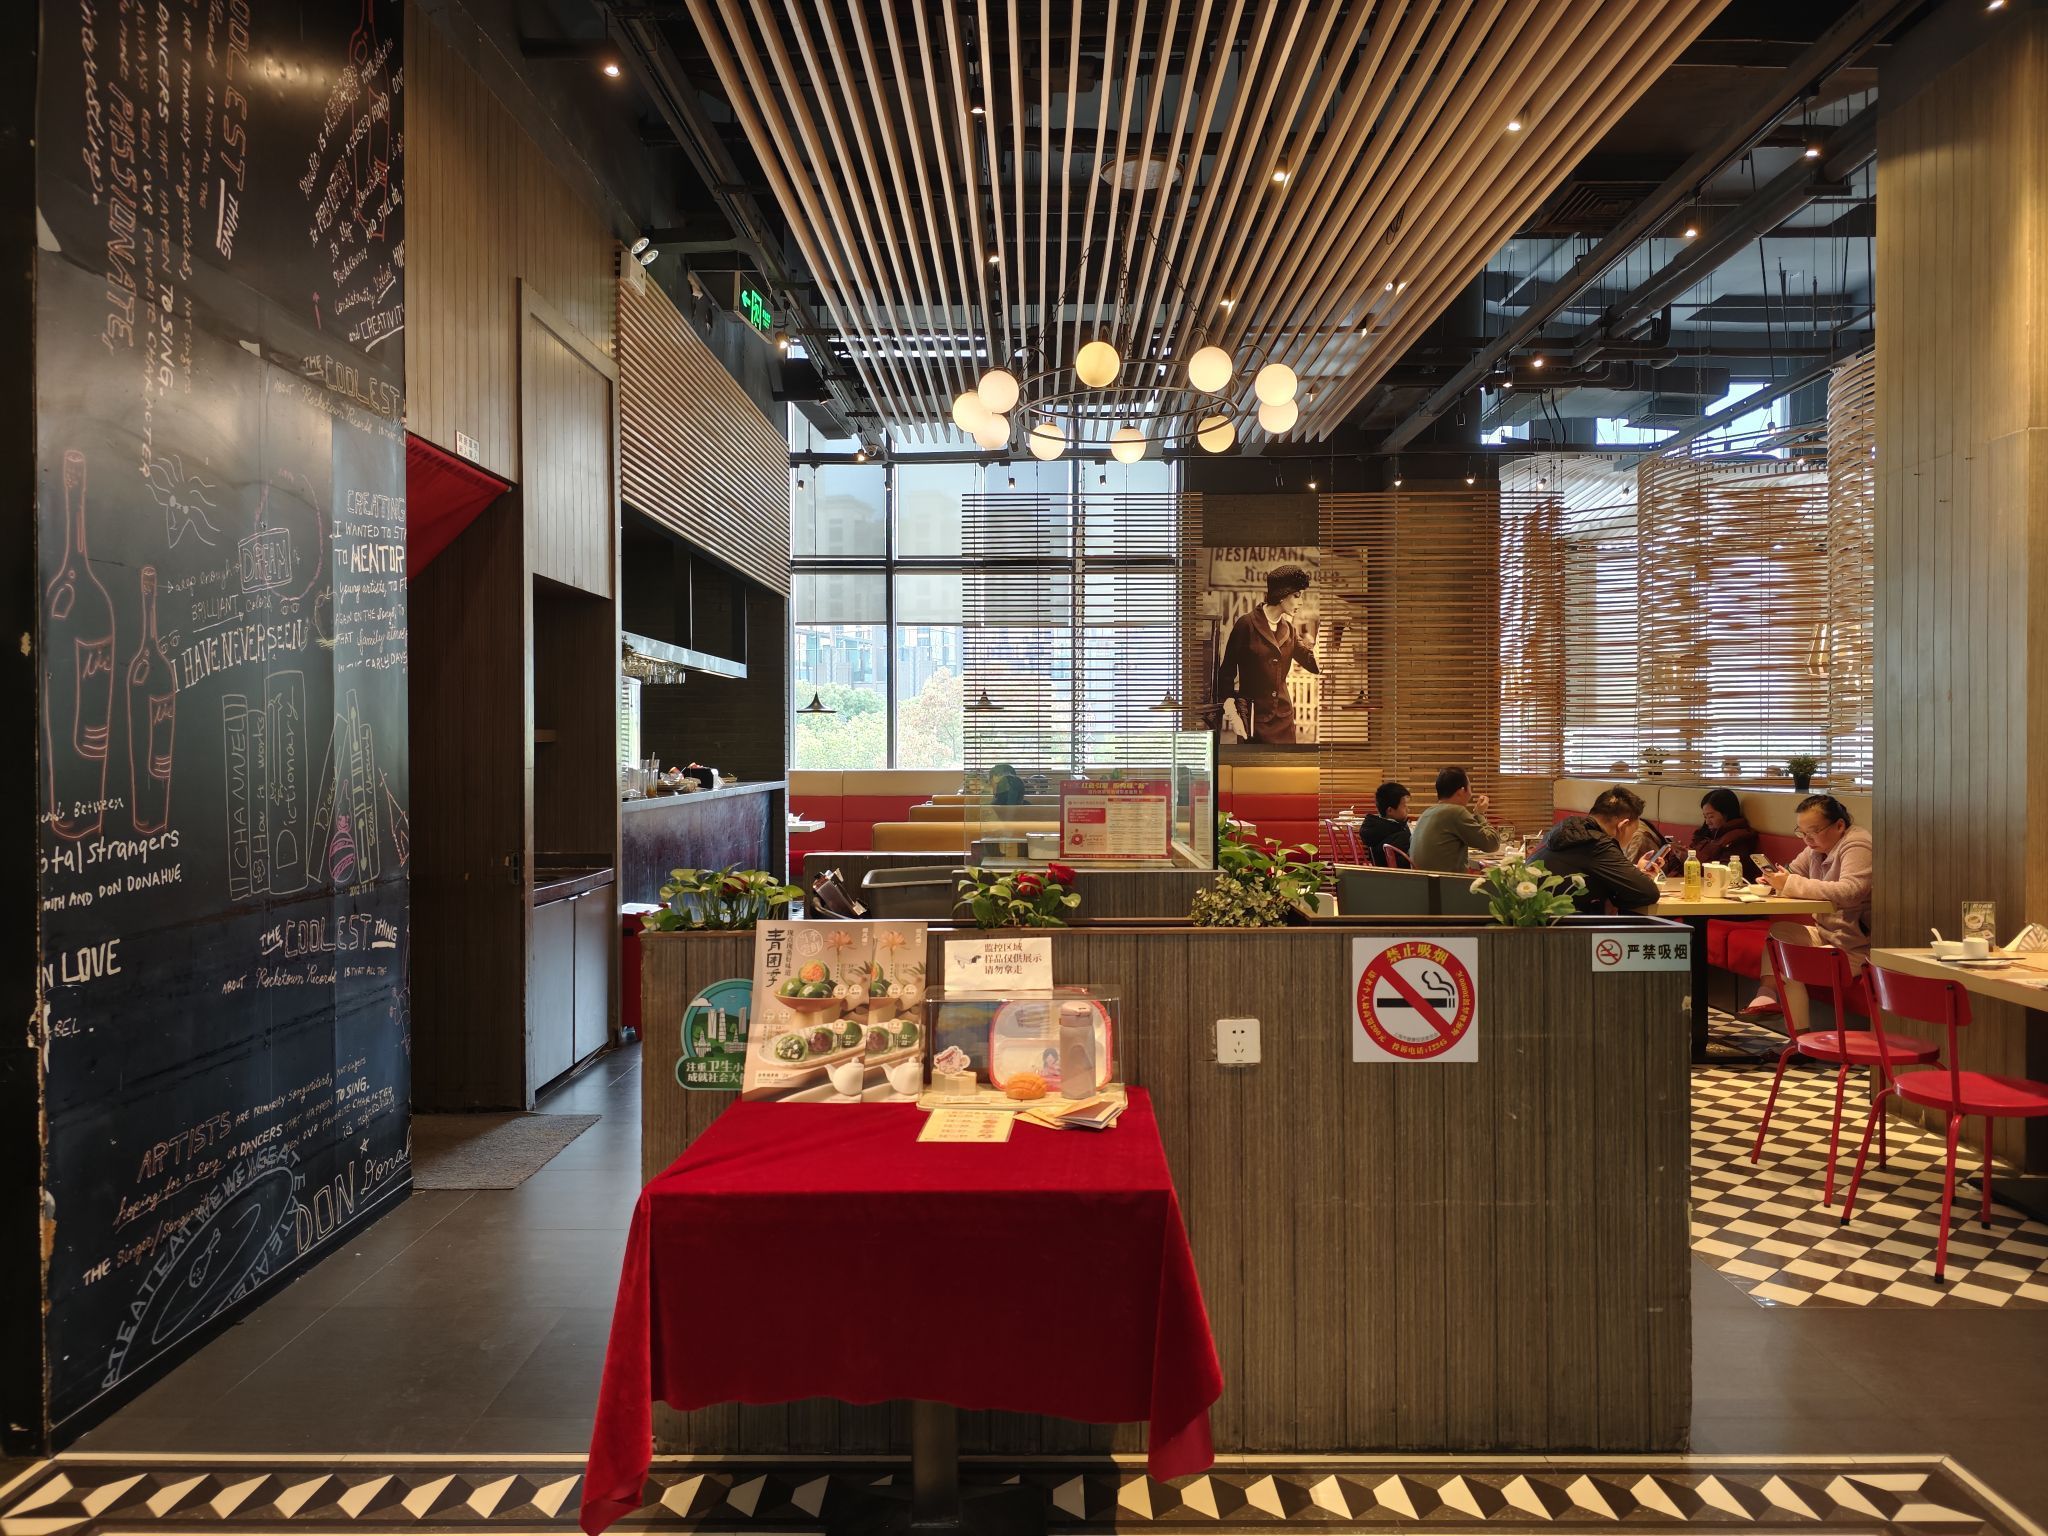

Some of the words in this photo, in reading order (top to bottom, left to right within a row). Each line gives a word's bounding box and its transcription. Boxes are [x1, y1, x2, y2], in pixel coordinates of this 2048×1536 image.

[182, 12, 192, 52] ARE
[156, 2, 170, 124] DANCERS
[180, 58, 191, 149] PRIMARILY
[205, 107, 213, 147] THAT
[135, 1, 148, 94] ALWAYS
[142, 228, 156, 323] FAVORITE
[158, 130, 168, 179] THAT
[202, 149, 211, 175] ALL
[102, 82, 137, 356] PASSIONATE,
[160, 188, 171, 274] HAPPEN
[221, 193, 239, 260] THING
[160, 283, 174, 312] TO
[184, 296, 192, 331] NOT
[304, 355, 321, 370] THE
[325, 355, 400, 419] COOLEST
[347, 489, 405, 522] CREATING
[345, 522, 379, 538] WANTED
[381, 526, 392, 539] TO
[334, 548, 349, 566] TO
[350, 542, 405, 574] MENTOR
[388, 580, 398, 592] TO
[191, 594, 240, 623] BRILLIANT
[181, 637, 220, 689] HAVE
[221, 623, 267, 670] NEVER
[267, 619, 304, 653] SEEN
[365, 655, 390, 669] EARLY
[229, 715, 250, 869] CHANNEL
[276, 686, 299, 870] Dictionary
[74, 797, 124, 818] Between
[87, 829, 180, 864] strangers
[69, 891, 93, 907] AND
[99, 879, 122, 898] DON
[259, 924, 281, 947] THE
[284, 913, 372, 958] COOLEST
[375, 918, 398, 942] THING
[984, 942, 1023, 953] 监控区域
[1386, 943, 1449, 965] 禁止吸烟
[1627, 944, 1688, 960] 严禁吸烟
[62, 938, 121, 983] LOVE
[984, 953, 1042, 964] 样品仅供展示
[984, 964, 1023, 975] 请勿拿走
[222, 974, 247, 995] ABOUT
[344, 966, 350, 977] IS
[351, 967, 363, 977] THAT
[366, 966, 376, 976] ALL
[377, 966, 388, 977] THE
[136, 1110, 231, 1184] ARTISTS
[235, 1110, 250, 1128] ARE
[253, 1095, 286, 1119] PRIMARILY
[227, 1147, 236, 1160] OR
[240, 1123, 283, 1157] DANCERS
[285, 1113, 302, 1133] THAT
[305, 1097, 333, 1120] HAPPEN
[336, 1087, 346, 1105] TO
[83, 1257, 111, 1286] THE
[322, 1102, 351, 1131] FAVORITE
[296, 1160, 355, 1254] DON
